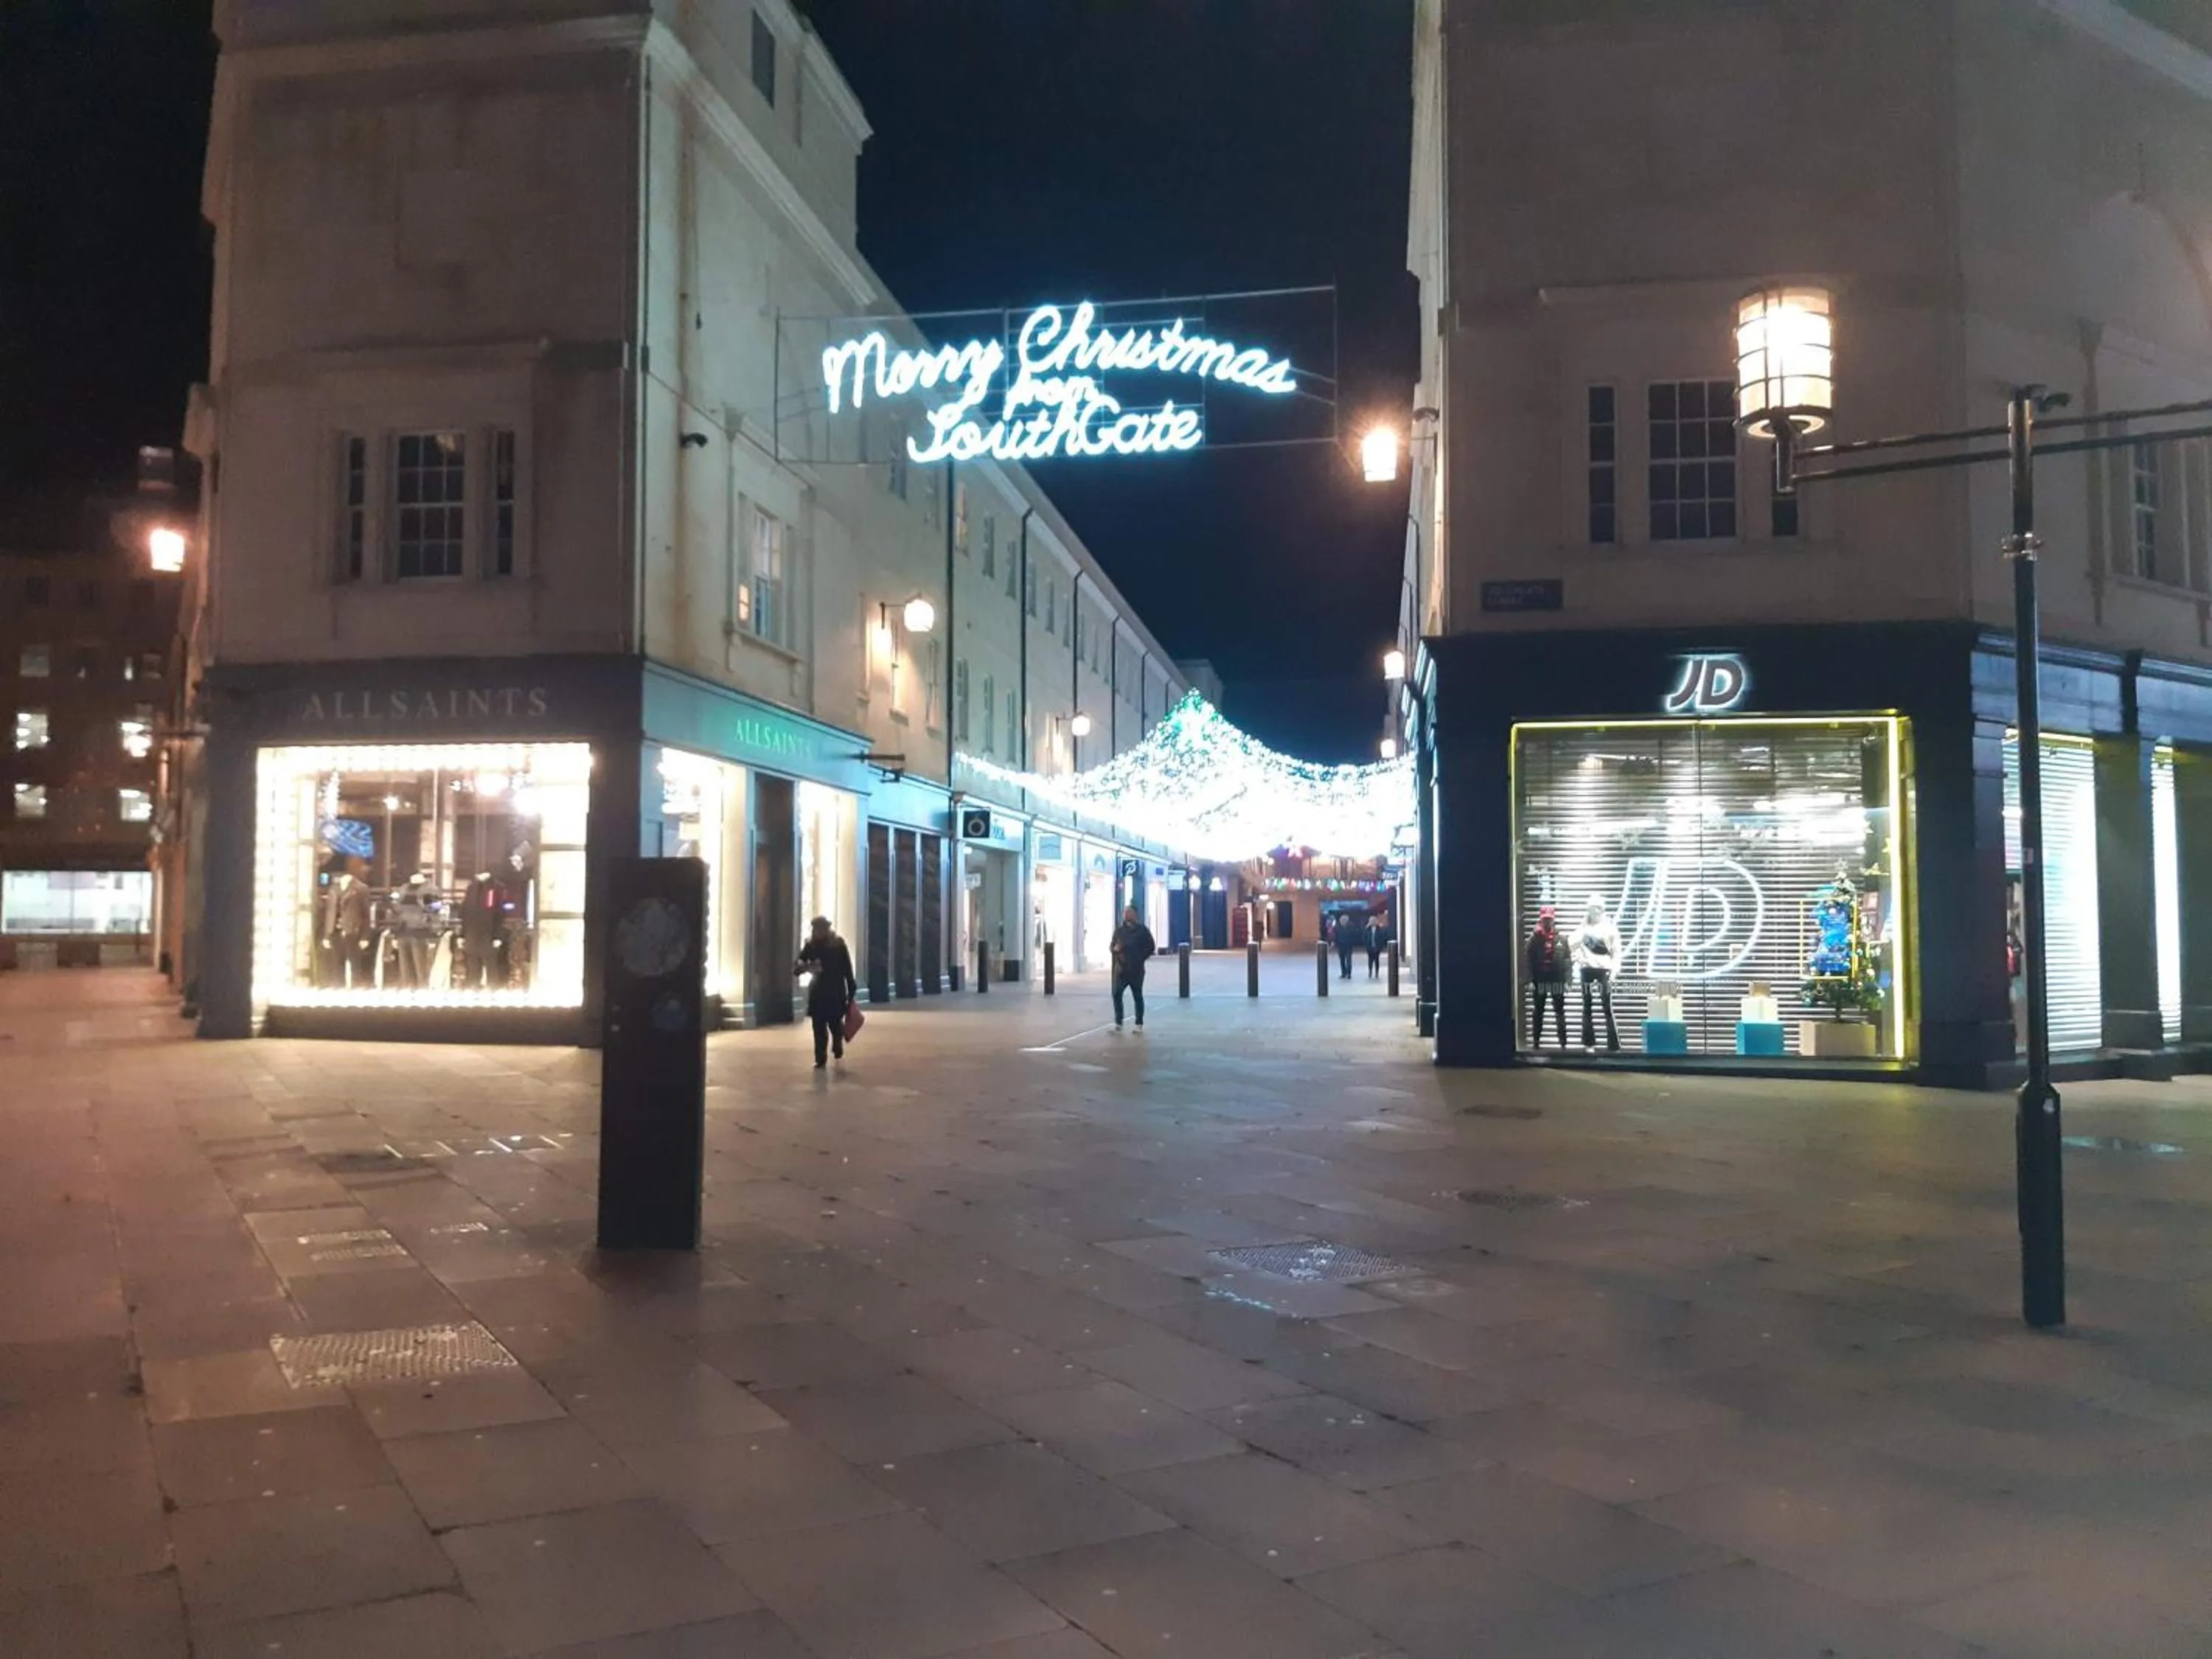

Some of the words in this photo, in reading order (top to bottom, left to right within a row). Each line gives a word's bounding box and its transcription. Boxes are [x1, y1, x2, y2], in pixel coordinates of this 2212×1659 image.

[301, 687, 548, 720] ALLSAINTS
[1666, 656, 1745, 710] JD
[734, 718, 813, 757] ALLSAINTS
[1612, 858, 1764, 979] JD
